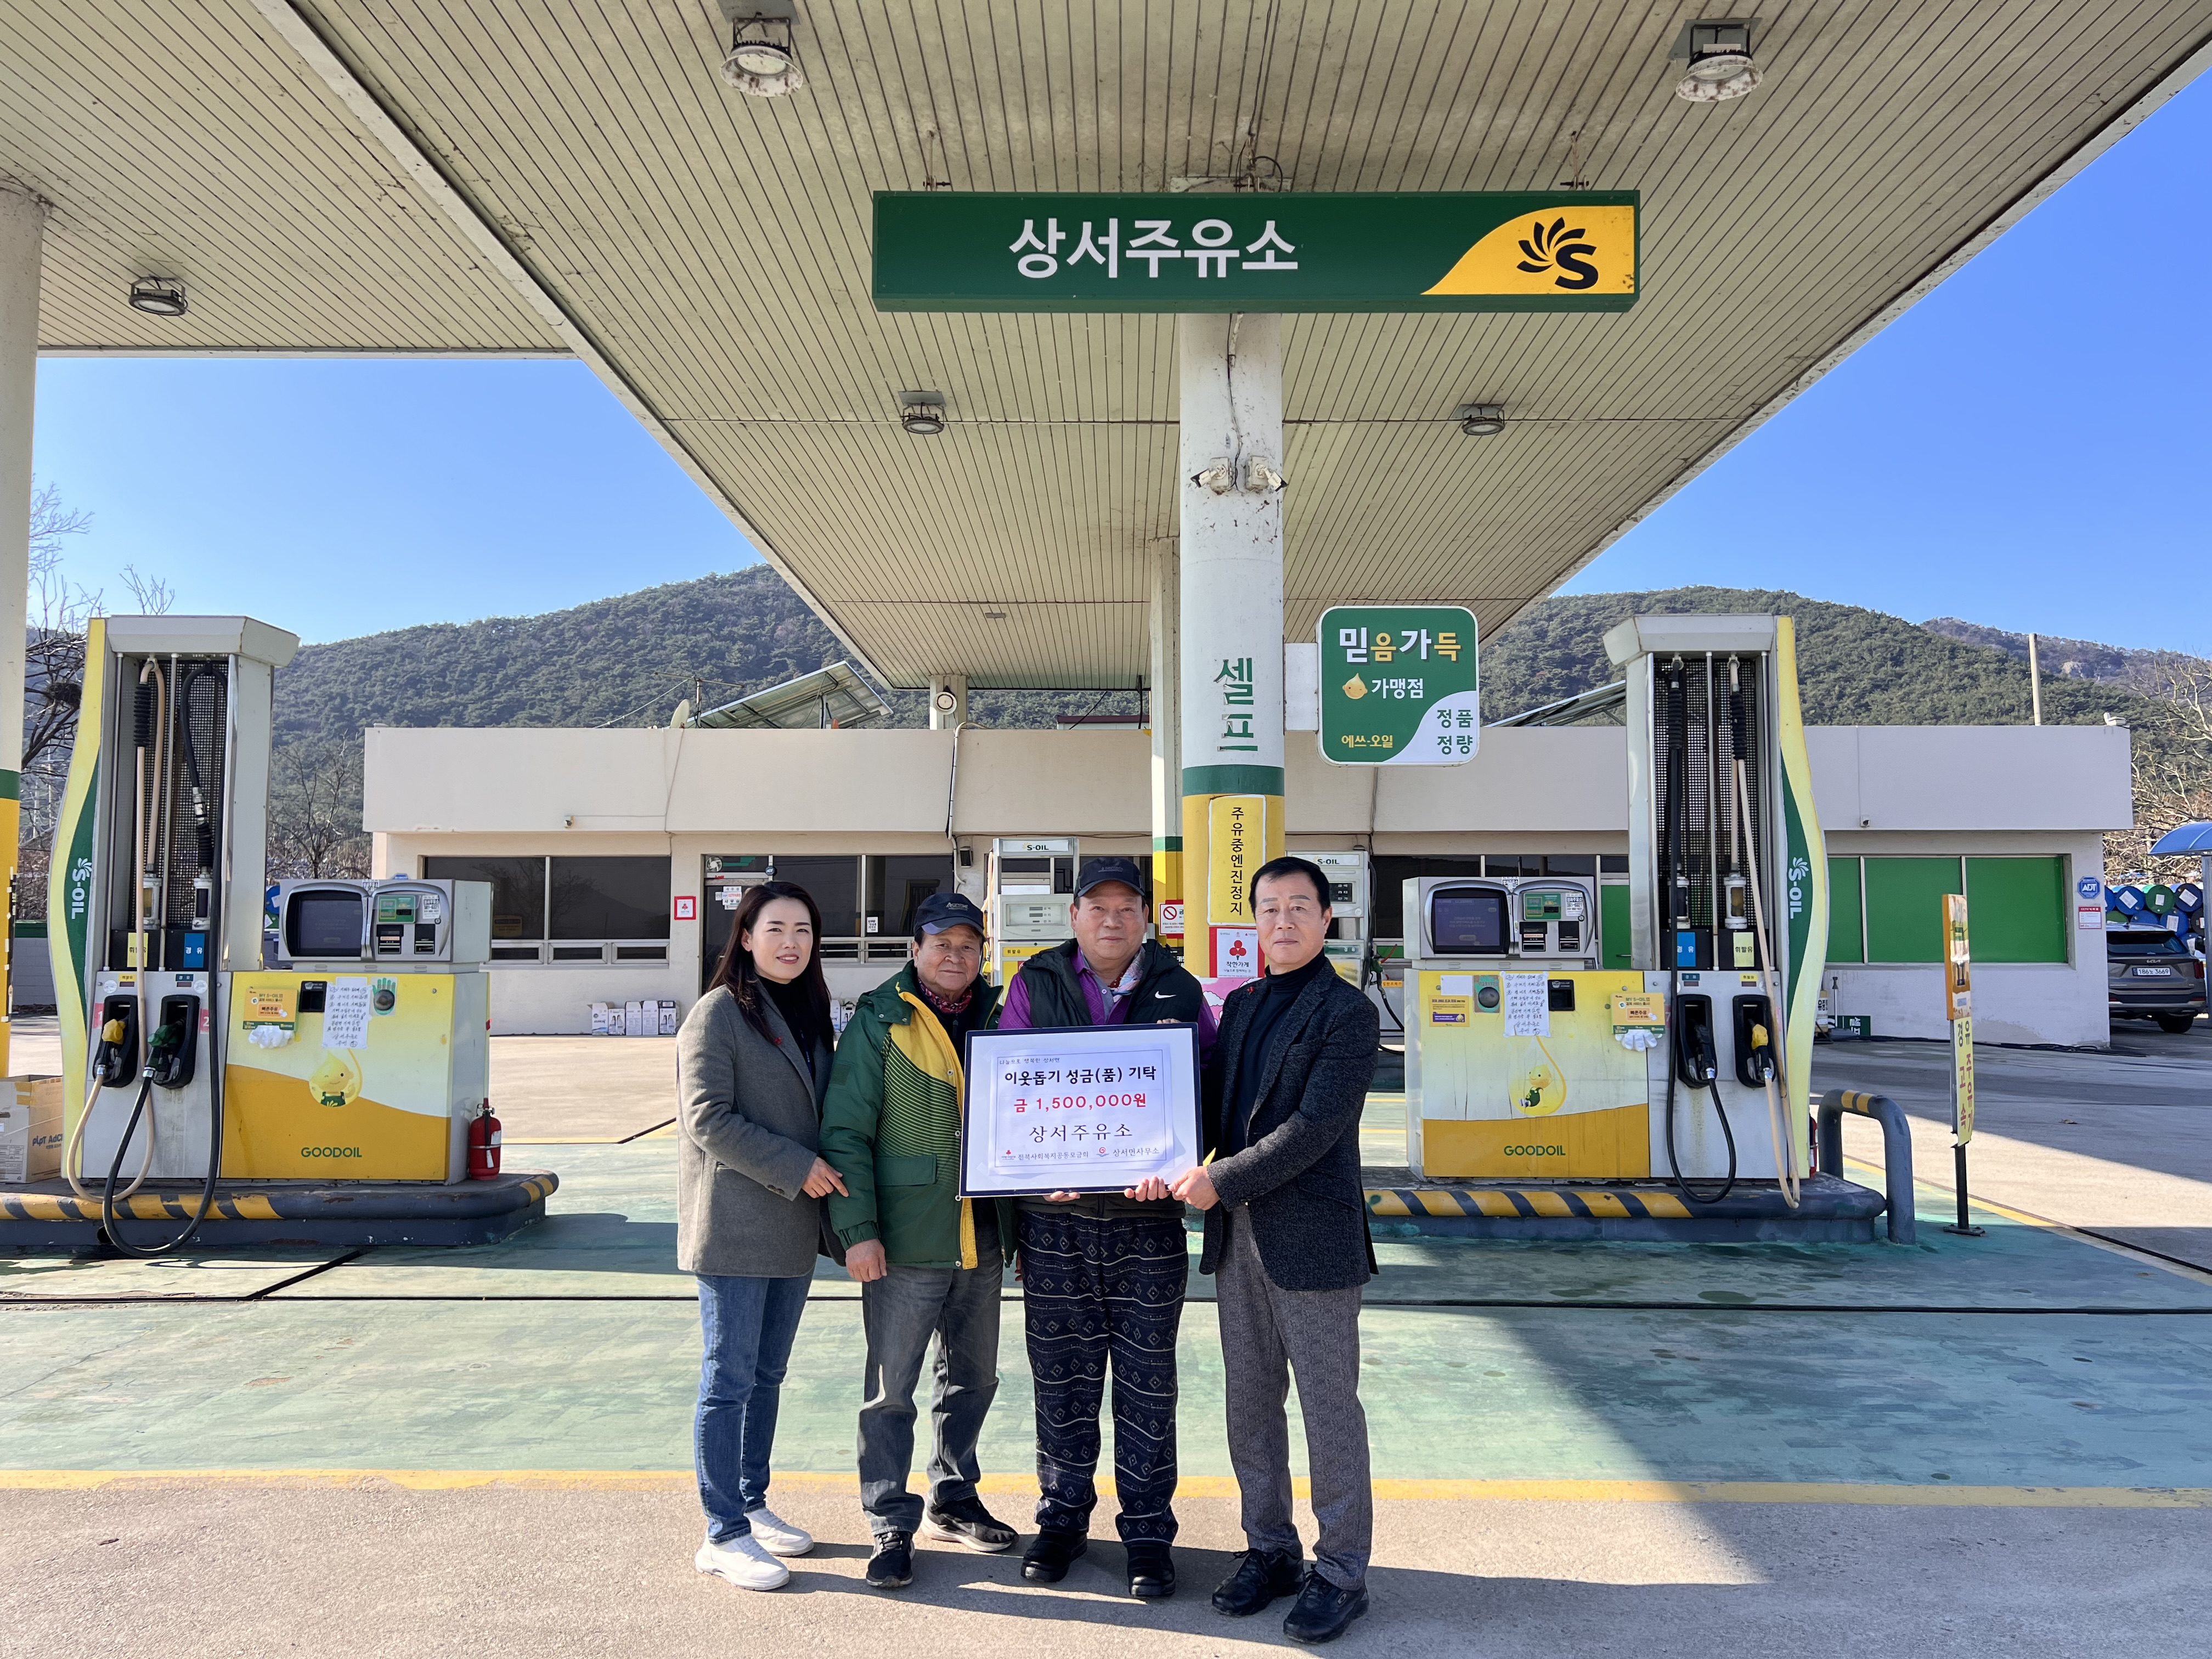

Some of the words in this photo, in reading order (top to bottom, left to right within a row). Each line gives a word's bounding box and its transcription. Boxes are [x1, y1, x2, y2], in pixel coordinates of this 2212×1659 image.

[1010, 218, 1298, 279] 상서주유소
[1339, 627, 1461, 663] 믿음가득
[1372, 678, 1424, 699] 가맹점
[1214, 657, 1258, 751] 셀프
[1437, 709, 1474, 729] 정품
[1341, 735, 1393, 748] 에쓰-오일
[1437, 735, 1474, 755] 정량
[72, 868, 86, 919] S-OIL
[1788, 868, 1802, 919] S-OIL
[98, 1011, 103, 1021] 1
[203, 1016, 209, 1027] 2
[1957, 1020, 1971, 1047] 경유
[1005, 1070, 1060, 1086] 이웃돕기
[1066, 1067, 1123, 1085] 성금(품)
[1128, 1066, 1157, 1081] 기탁
[1013, 1098, 1028, 1113] 금
[1036, 1093, 1147, 1111] 1,500,000원
[1029, 1123, 1133, 1143] 상서주유소
[301, 1147, 362, 1158] GOODOIL
[1113, 1148, 1160, 1158] 상서면사무소
[1504, 1145, 1566, 1156] GOODOIL
